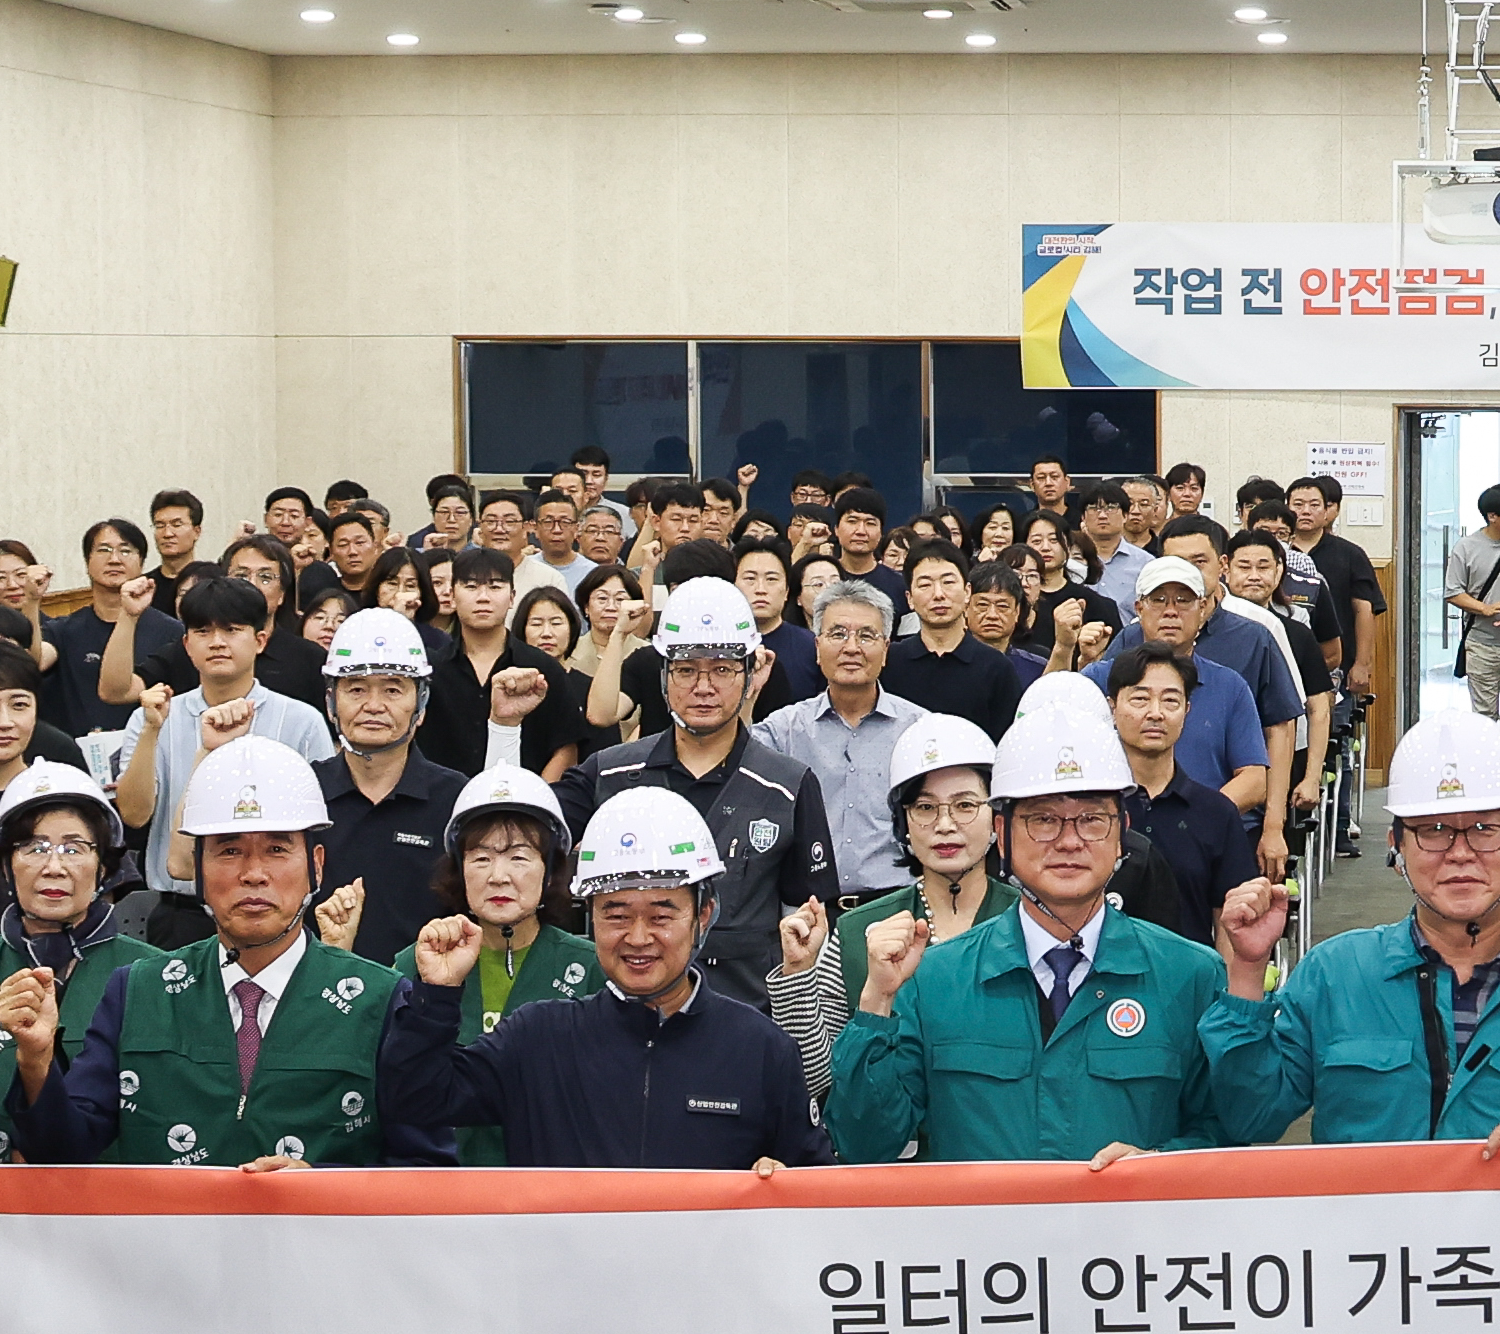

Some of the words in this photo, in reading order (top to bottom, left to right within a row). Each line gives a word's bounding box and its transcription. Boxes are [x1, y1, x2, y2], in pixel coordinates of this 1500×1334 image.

[1133, 267, 1222, 316] 작업
[1240, 267, 1283, 316] 전
[1300, 267, 1497, 320] 안전점검,
[1080, 1248, 1316, 1333] 안전이
